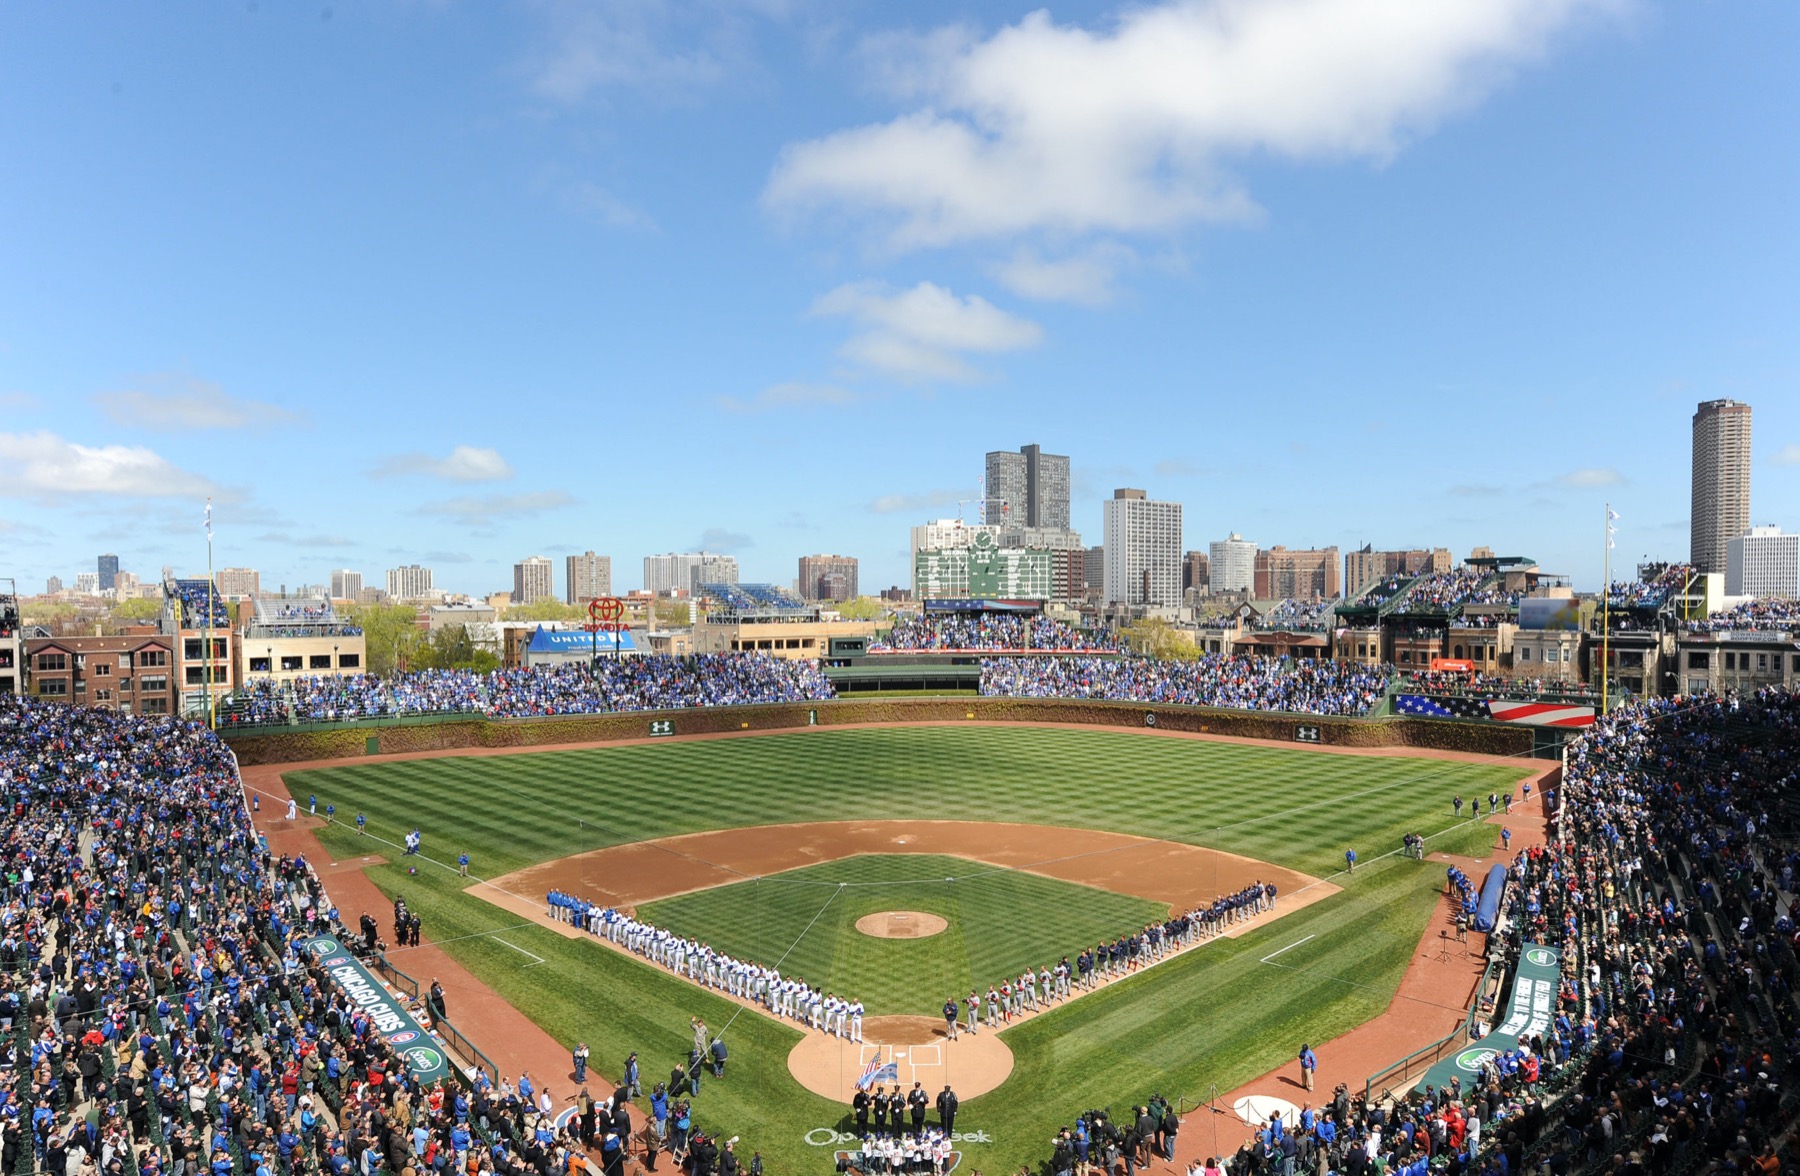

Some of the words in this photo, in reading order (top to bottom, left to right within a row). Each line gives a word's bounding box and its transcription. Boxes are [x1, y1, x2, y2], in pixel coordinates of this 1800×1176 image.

[584, 624, 630, 633] TOYOTA
[332, 966, 381, 1005] CHICAGO
[366, 1004, 405, 1032] CUBS
[410, 1050, 432, 1070] Scotts
